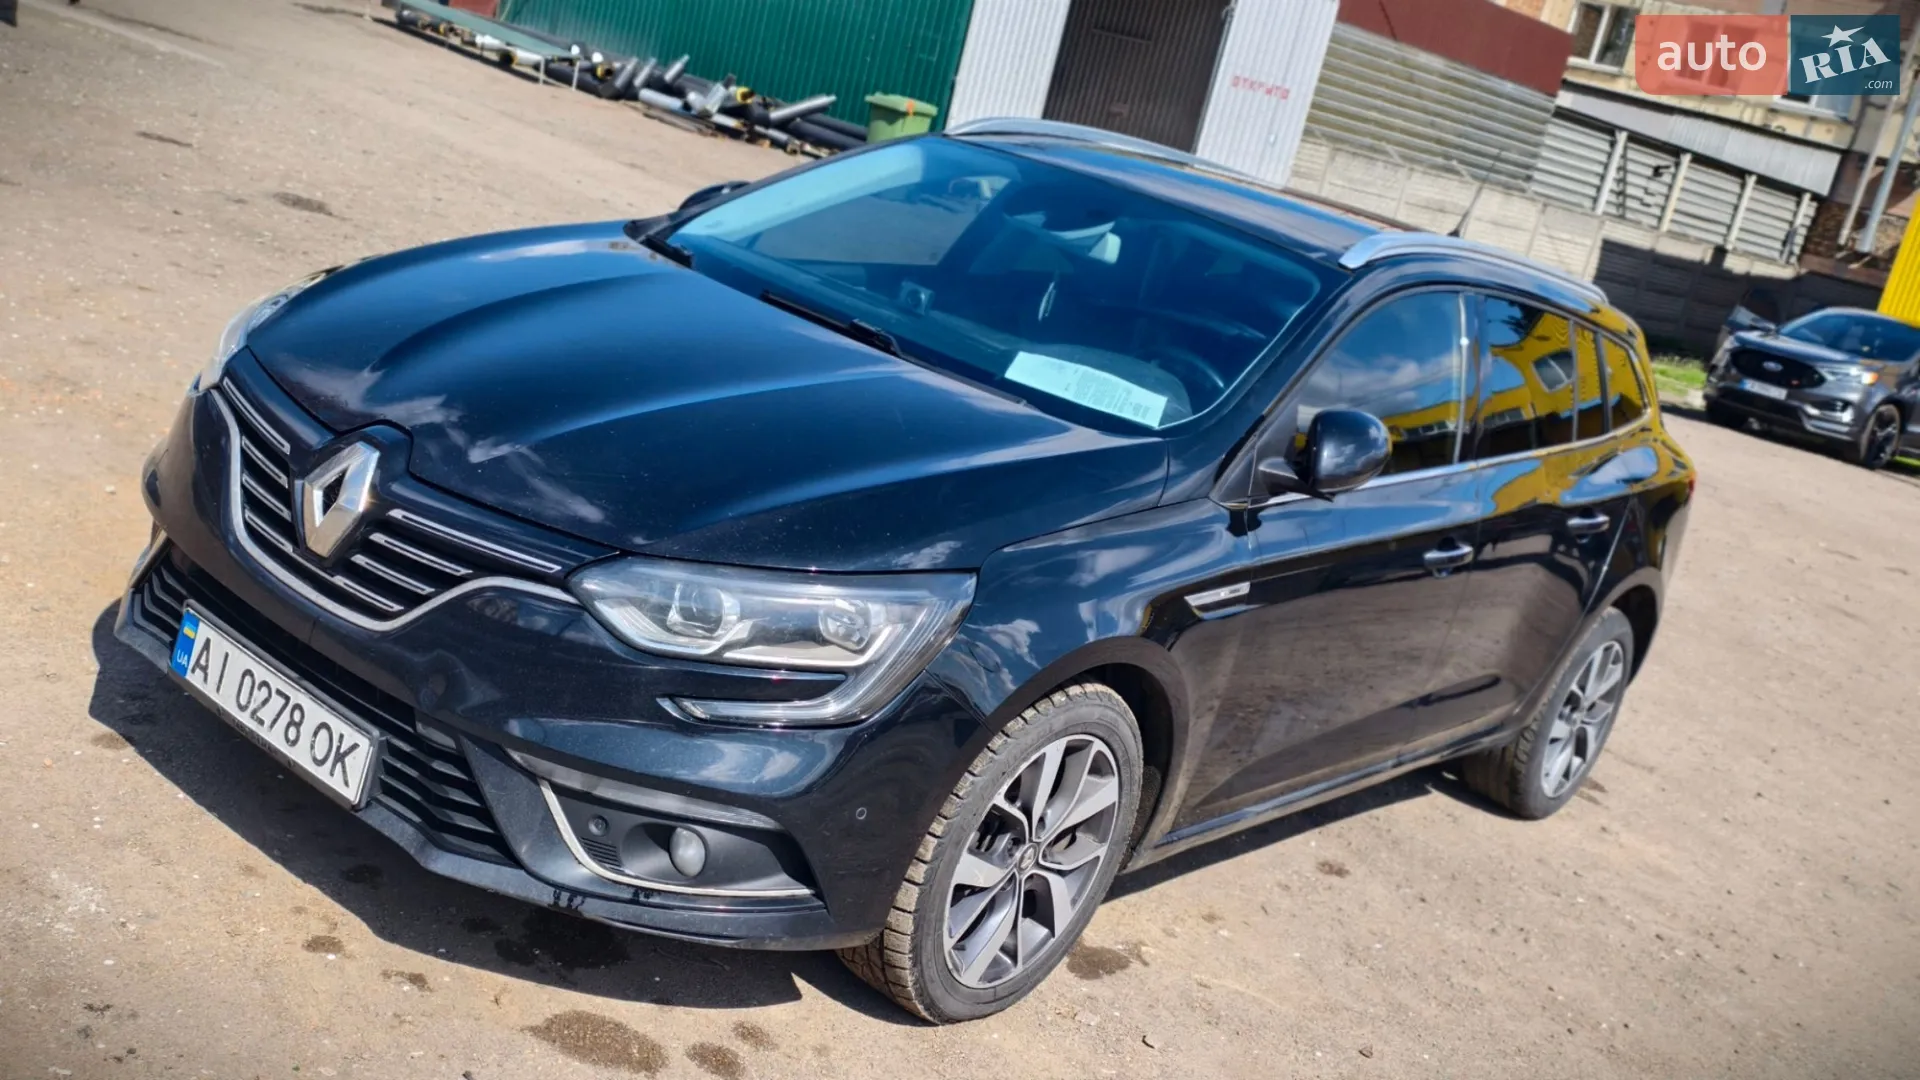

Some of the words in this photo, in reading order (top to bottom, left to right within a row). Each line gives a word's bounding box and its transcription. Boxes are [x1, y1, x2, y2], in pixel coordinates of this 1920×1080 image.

[176, 649, 188, 667] UA
[191, 637, 229, 694] AI
[236, 668, 305, 748] 0278
[310, 722, 361, 788] OK
